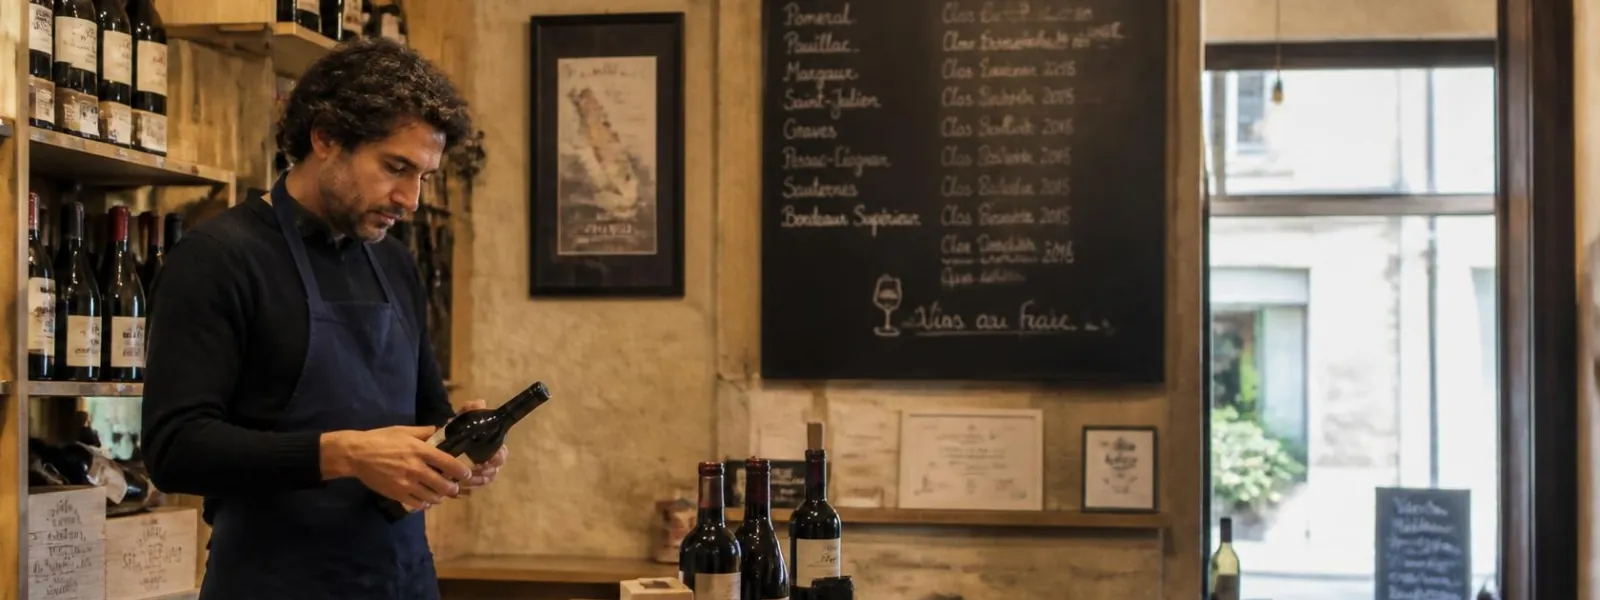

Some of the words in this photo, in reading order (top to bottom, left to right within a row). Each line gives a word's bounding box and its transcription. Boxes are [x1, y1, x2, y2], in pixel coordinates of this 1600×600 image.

[783, 88, 882, 119] Saint-Julien
[941, 85, 974, 107] Clos
[782, 118, 838, 140] Graves
[941, 115, 973, 137] Clos
[914, 301, 966, 331] Vins
